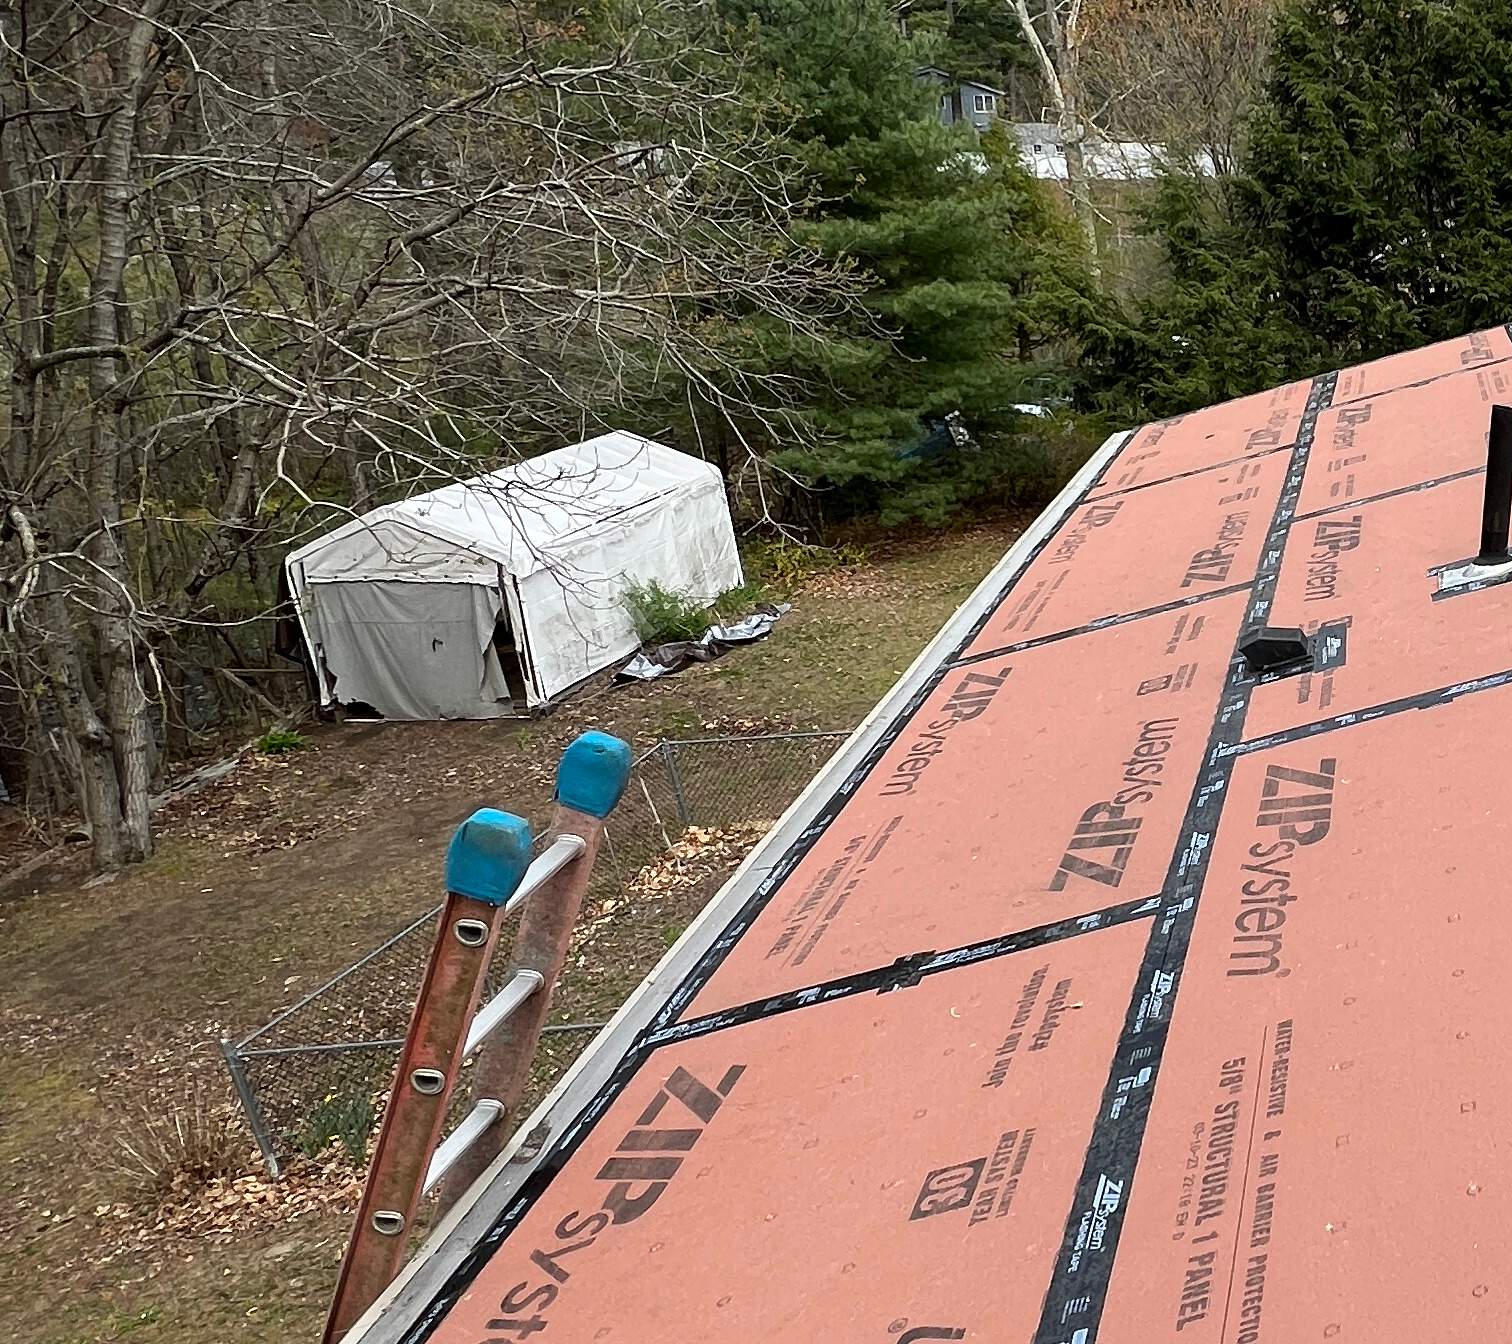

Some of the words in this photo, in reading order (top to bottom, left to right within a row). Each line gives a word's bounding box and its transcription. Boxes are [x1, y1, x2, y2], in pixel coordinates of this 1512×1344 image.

[969, 1184, 999, 1227] YEAR
[986, 1130, 1018, 1179] SYSTEM
[1195, 1100, 1238, 1226] STRUCTURAL
[1192, 1230, 1219, 1244] 1
[1249, 1185, 1276, 1248] BARRIER
[1176, 1250, 1213, 1332] PANEL
